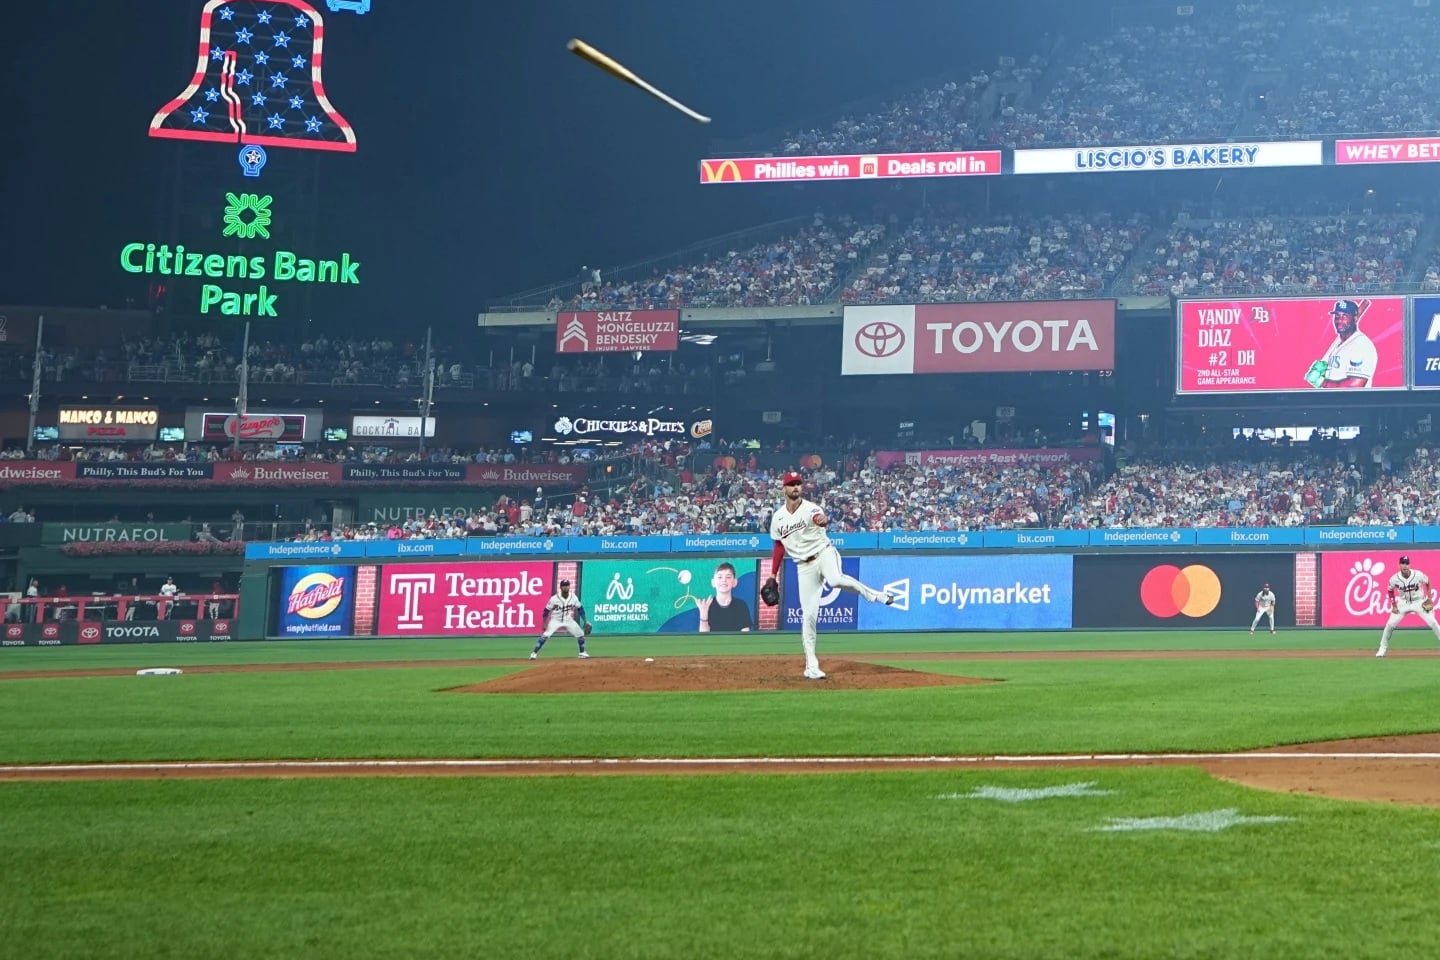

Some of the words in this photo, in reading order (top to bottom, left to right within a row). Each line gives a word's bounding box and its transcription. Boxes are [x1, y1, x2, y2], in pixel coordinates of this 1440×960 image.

[1076, 150, 1165, 168] LISCIO'S
[1173, 146, 1258, 165] BAKERY
[1346, 144, 1402, 160] WHEY
[754, 161, 816, 178] Phillies
[818, 160, 849, 176] win
[887, 159, 936, 174] Deals
[938, 157, 967, 172] roll
[969, 157, 986, 172] in
[121, 242, 265, 280] Citizens
[274, 250, 360, 284] Bank
[201, 286, 278, 317] Park
[597, 312, 632, 322] SALTZ
[1198, 308, 1242, 325] YANDY
[597, 322, 674, 332] MONGELUZZI
[596, 334, 657, 344] BENDESKY
[927, 319, 1099, 354] TOYOTA
[1198, 325, 1231, 347] DÍAZ
[1208, 351, 1226, 366] #2
[1237, 350, 1255, 365] DH
[1210, 369, 1240, 377] ALL-STAR
[1216, 377, 1257, 385] APPEARANCE
[60, 410, 102, 424] MANCO
[104, 410, 112, 424] &
[115, 411, 157, 424] MANCO
[87, 426, 126, 436] PIZZA
[356, 426, 400, 435] COCKTAIL
[83, 467, 115, 477] Philly,
[117, 467, 140, 476] This
[142, 466, 167, 476] Bud's
[169, 467, 186, 476] For
[187, 467, 204, 476] You
[254, 467, 328, 480] Budweiser
[350, 469, 378, 478] Philly,
[380, 469, 400, 477] This
[402, 469, 426, 477] Bud's
[428, 469, 442, 477] For
[503, 469, 572, 481] Budweiser
[63, 528, 169, 541] NUTRAFOL
[893, 534, 956, 545] Independence
[1017, 533, 1055, 543] ibx.com
[1104, 531, 1169, 543] Independence
[1231, 531, 1269, 542] ibx.com
[1319, 528, 1385, 540] Independence
[398, 543, 434, 552] ibx.com
[481, 539, 542, 550] Independence
[601, 539, 637, 549] ibx.com
[685, 536, 749, 548] Independence
[269, 545, 330, 554] Independence
[445, 572, 542, 603] Temple
[287, 577, 344, 615] Hatfield
[920, 581, 1051, 609] Polymarket
[594, 603, 648, 613] NEMOURS
[788, 608, 853, 616] ROHMAN
[443, 603, 535, 628] Health
[594, 613, 625, 621] CHILDREN'S
[106, 626, 160, 637] TOYOTA
[286, 623, 341, 633] simplyhatfield.com
